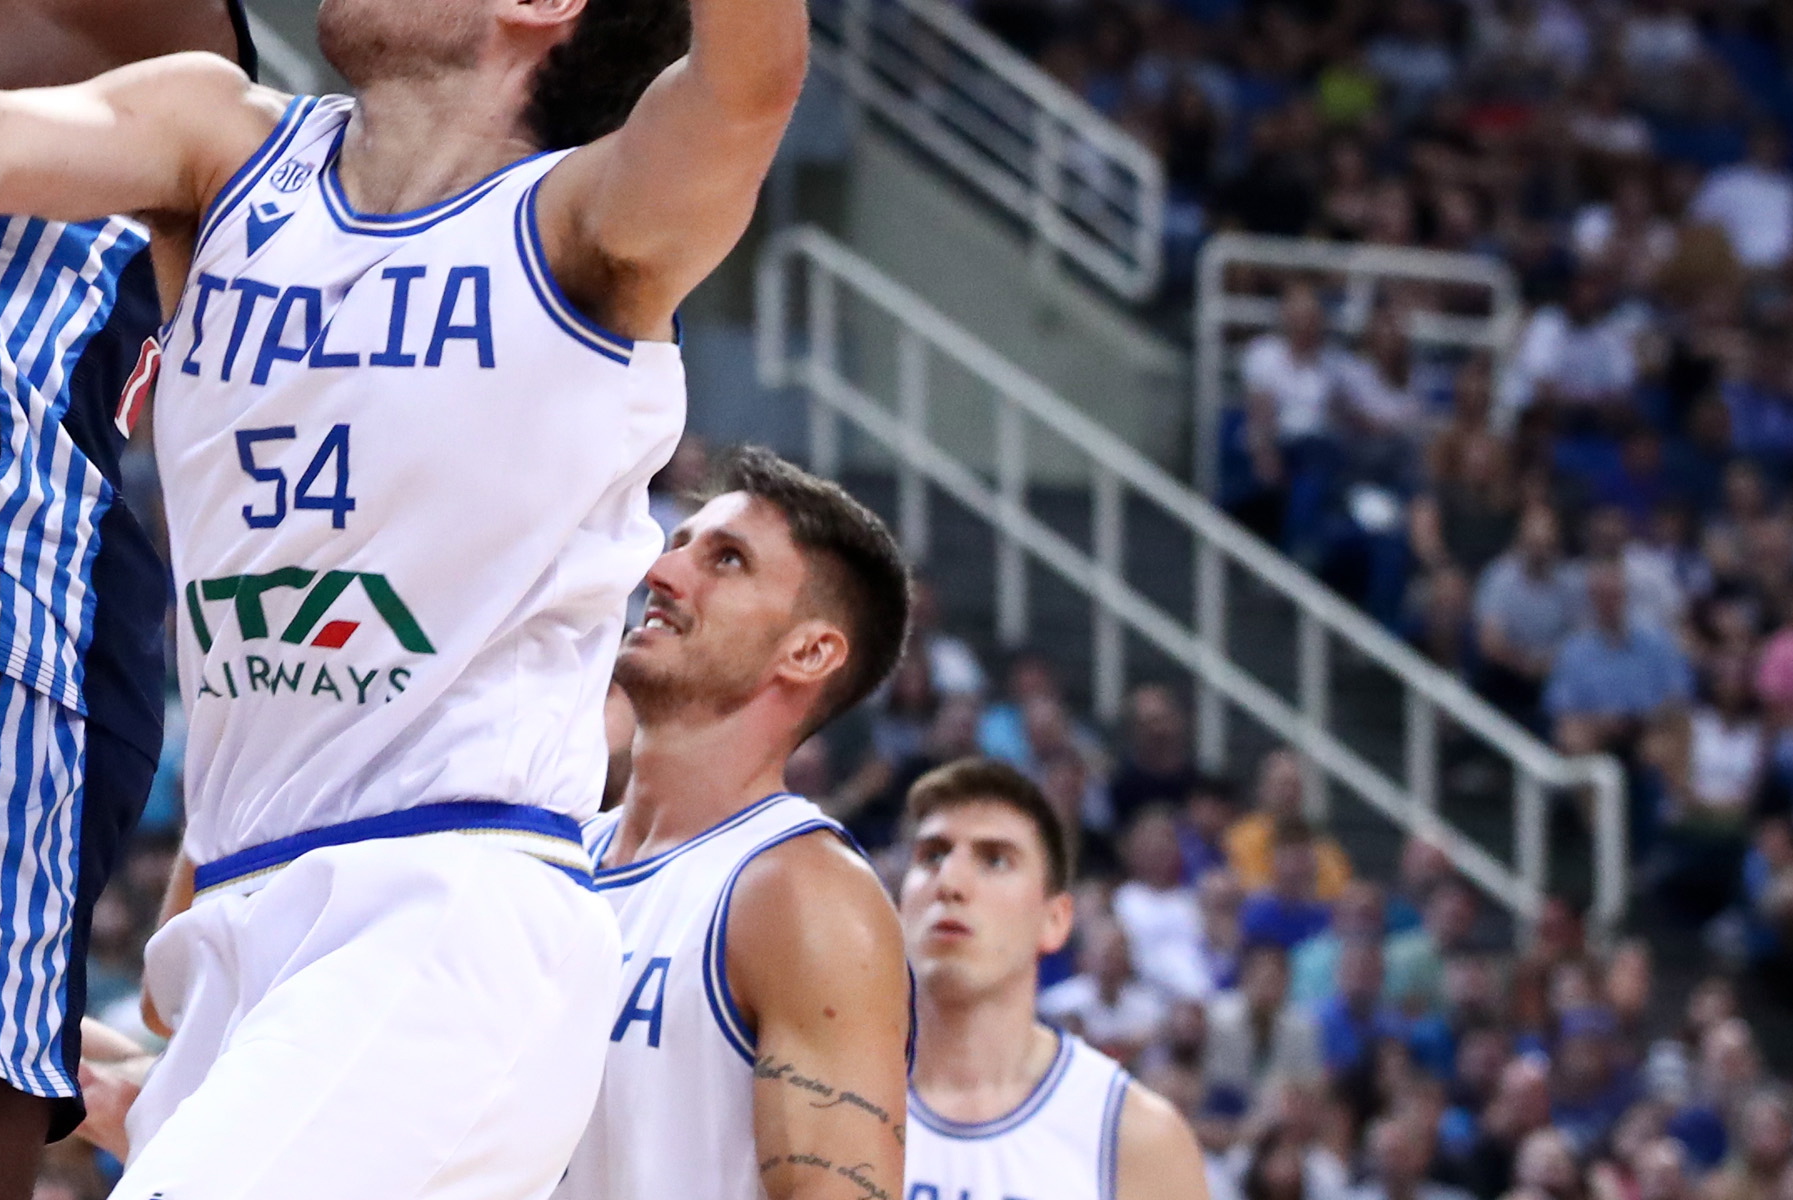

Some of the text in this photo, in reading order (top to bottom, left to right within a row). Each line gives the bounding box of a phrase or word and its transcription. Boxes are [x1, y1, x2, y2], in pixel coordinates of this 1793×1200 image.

[181, 266, 495, 386] ITALIA
[235, 424, 356, 529] 54
[186, 566, 438, 655] ITA
[197, 654, 412, 704] AIRWAYS
[610, 951, 672, 1049] A
